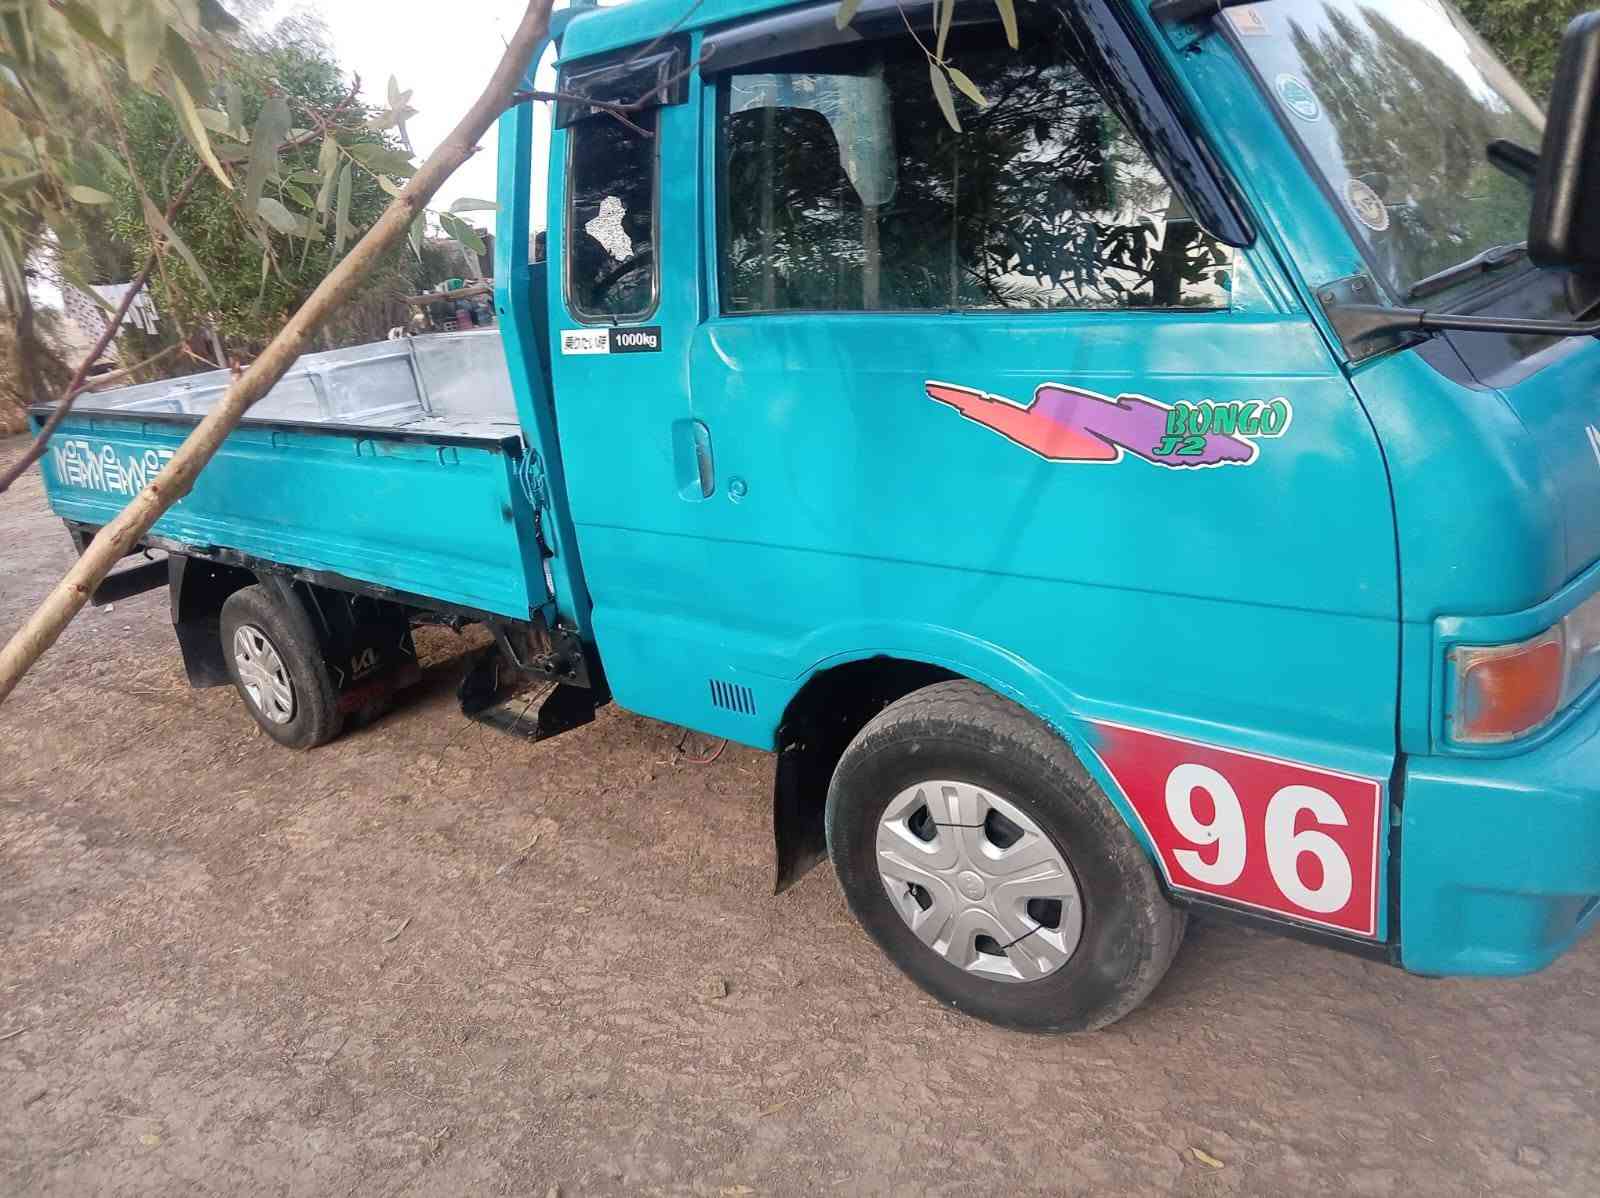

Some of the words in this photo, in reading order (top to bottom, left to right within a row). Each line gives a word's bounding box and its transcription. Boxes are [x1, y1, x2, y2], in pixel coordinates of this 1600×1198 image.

[615, 332, 657, 348] 1000kg
[1166, 399, 1288, 436] BONGO
[1152, 433, 1207, 456] J2
[1165, 763, 1353, 913] 96
